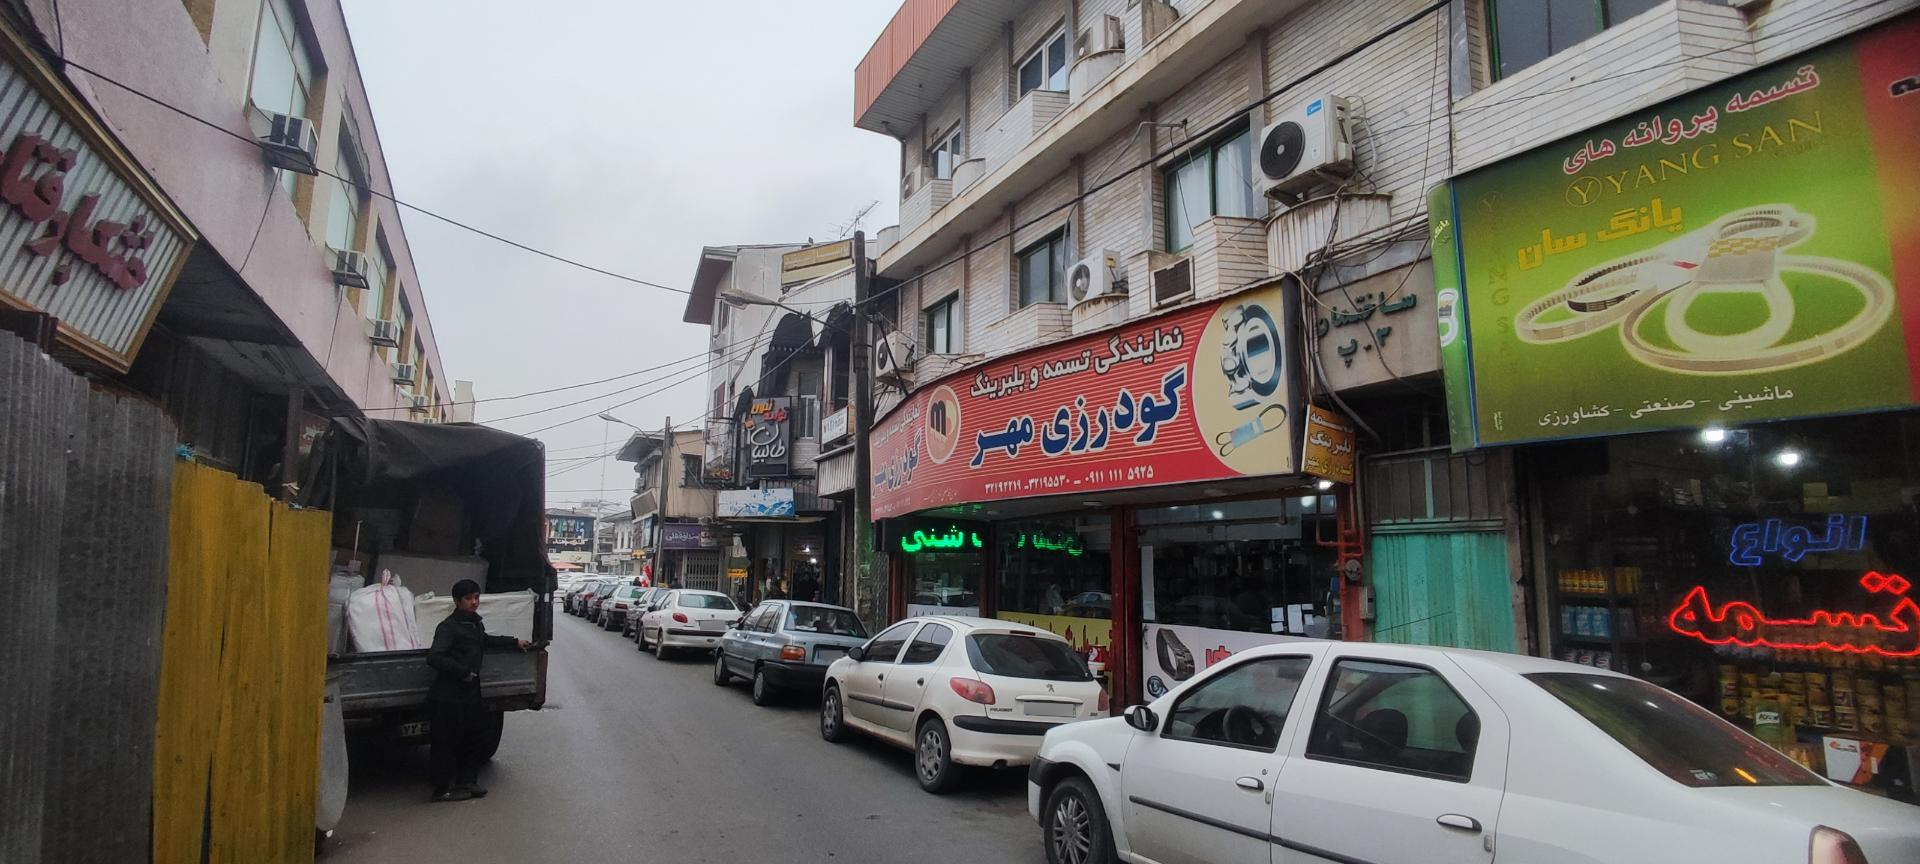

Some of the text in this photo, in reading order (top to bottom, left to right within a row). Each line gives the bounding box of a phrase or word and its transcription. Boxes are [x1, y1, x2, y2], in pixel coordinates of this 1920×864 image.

[1562, 64, 1821, 175] تسمه پروانه های
[1605, 142, 1720, 194] YANG
[1732, 111, 1826, 158] SAN
[1517, 198, 1685, 272] یانگ سان
[1317, 290, 1417, 337] ساختمان
[970, 326, 1184, 399] نمایندگی تسمه و بلبرینگ
[1041, 362, 1188, 456] گودرزی
[1538, 404, 1611, 427] کشاورزی
[1629, 397, 1696, 420] صنعتی
[1718, 384, 1795, 411] ماشینی
[969, 416, 1035, 468] مهر
[1729, 513, 1868, 567] انواع
[1668, 570, 1920, 657] تسمه
